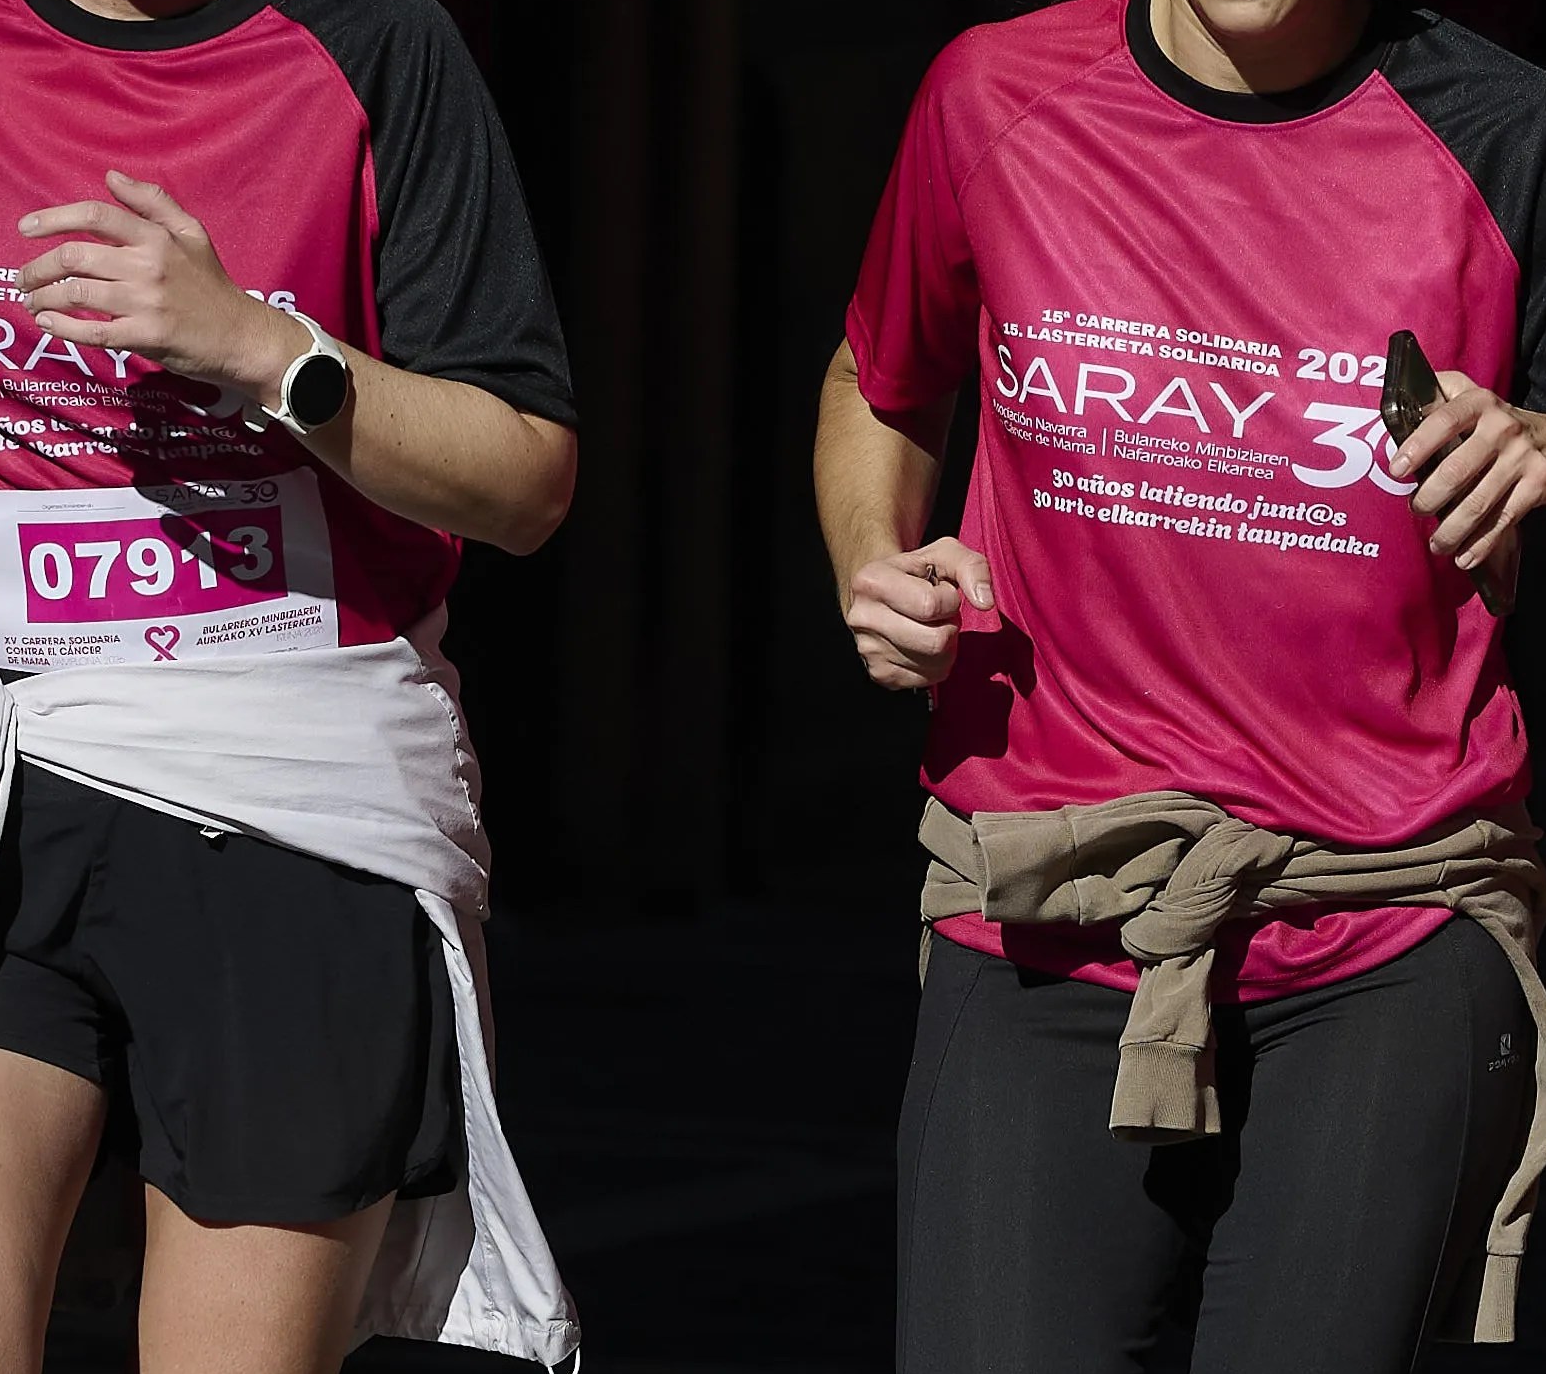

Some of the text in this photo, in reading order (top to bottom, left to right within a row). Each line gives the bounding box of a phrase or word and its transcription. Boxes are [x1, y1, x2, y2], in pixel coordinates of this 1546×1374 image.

[1002, 322, 1282, 378] 15. LASTERKETA SOLIDARIOA
[1041, 308, 1283, 359] 15ª CARRERA SOLIDARIA
[3, 377, 81, 393] Bularreko
[1295, 347, 1388, 388] 202
[995, 343, 1277, 440] SARAY
[1035, 416, 1290, 468] Navarra Bularreko Minbiziaren
[1052, 435, 1097, 456] Mama
[1112, 444, 1203, 471] Nafarroako
[1207, 458, 1275, 480] Elkartea
[155, 483, 233, 503] SARAY
[1051, 468, 1349, 527] 30 años latiendo junt@s
[1032, 489, 1381, 559] 30 urte elkarrekin taupadaka
[28, 525, 275, 601] 07913
[4, 634, 122, 647] XV CARRERA SOLIDARIA
[195, 614, 323, 647] AURKAKO XV LASTERKETA
[202, 615, 259, 636] BULARREKO
[5, 646, 46, 656] CONTRA
[58, 644, 102, 656] CÁNCER
[7, 656, 19, 666] DE
[20, 656, 51, 667] MAMA
